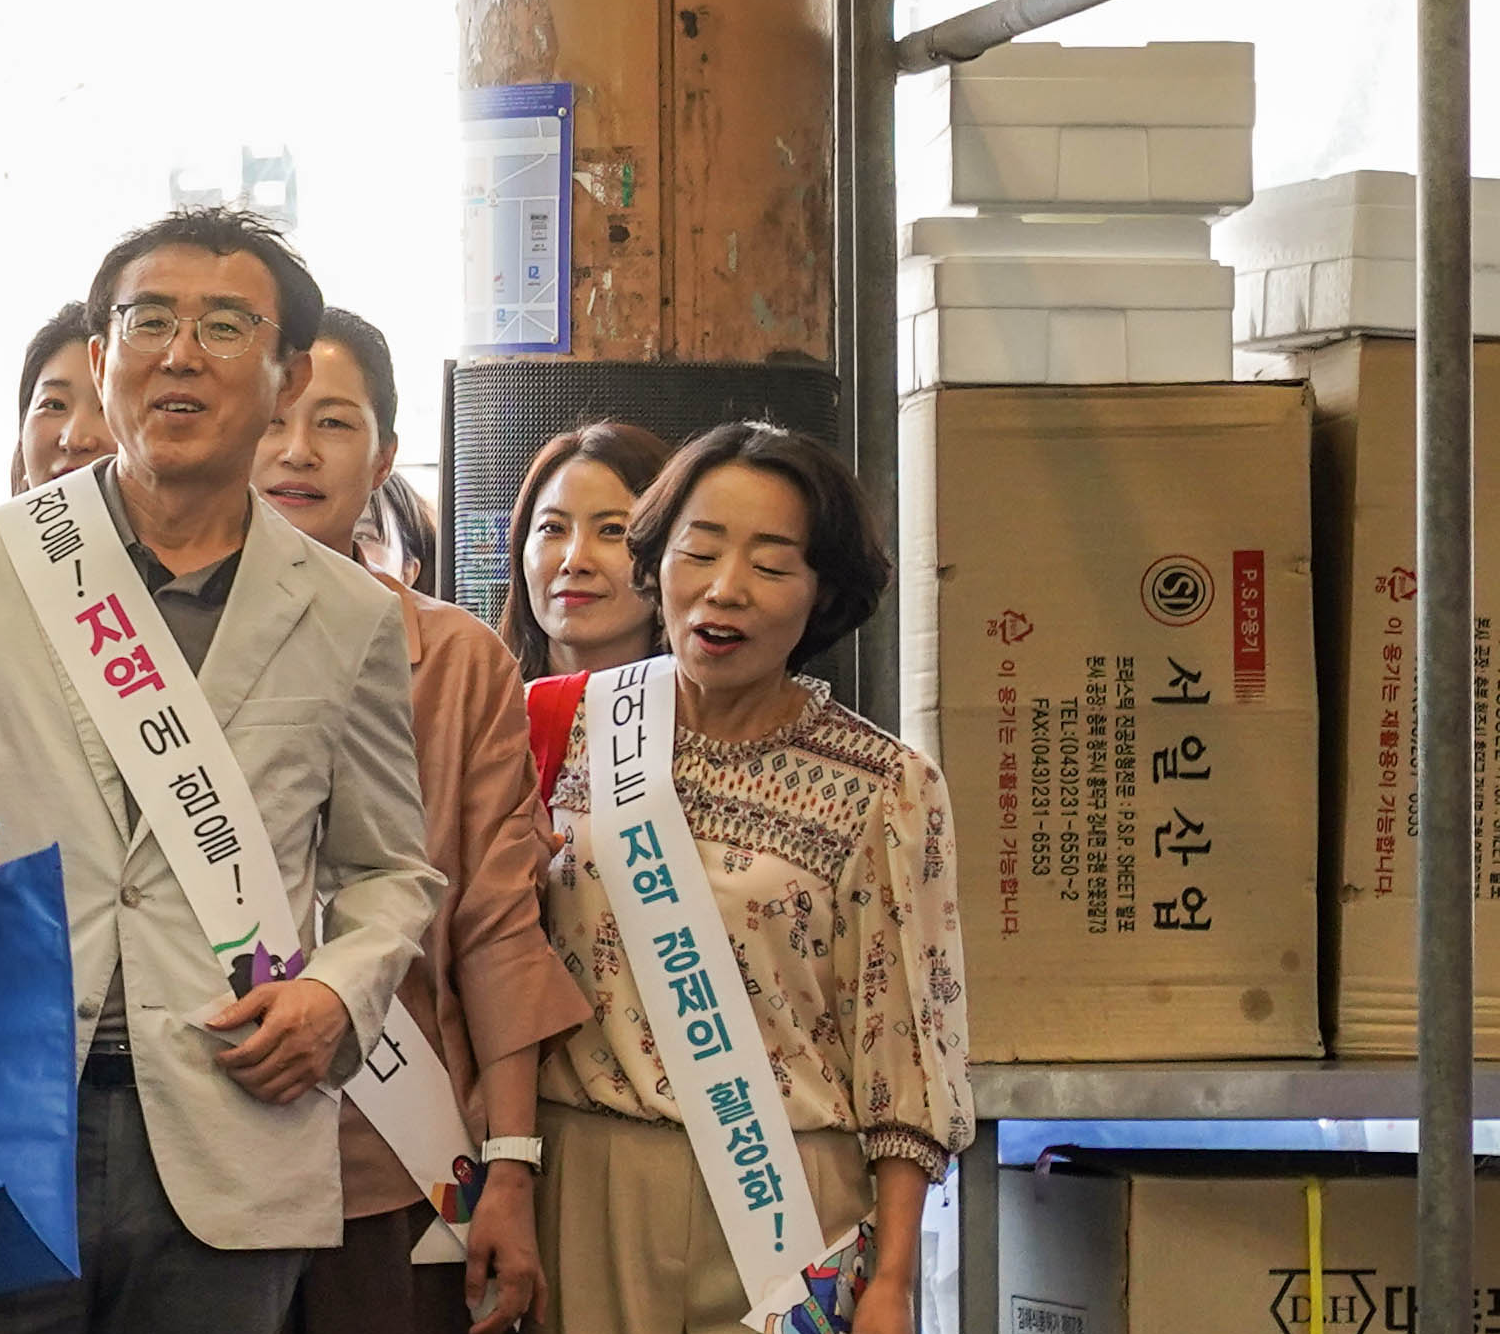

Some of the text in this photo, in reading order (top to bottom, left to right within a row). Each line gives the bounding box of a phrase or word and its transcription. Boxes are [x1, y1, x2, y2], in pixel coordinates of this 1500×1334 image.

[1240, 569, 1260, 653] P.S.P용기
[1383, 616, 1403, 635] 이
[1381, 643, 1402, 702] 용기는
[1086, 714, 1106, 736] 충북
[1086, 740, 1106, 773] 청주시
[1378, 708, 1400, 788] 재활용이
[998, 660, 1017, 941] 이 용기는 재활용이 가능합니다.
[1029, 698, 1050, 876] FAX:(043)231-6553
[1151, 656, 1212, 933] 서일산업
[168, 765, 245, 906] 힘을!
[1116, 855, 1135, 900] SHEET
[611, 661, 786, 1254] 피어나는 지역 경제의 활성화!
[1116, 906, 1135, 933] 발포
